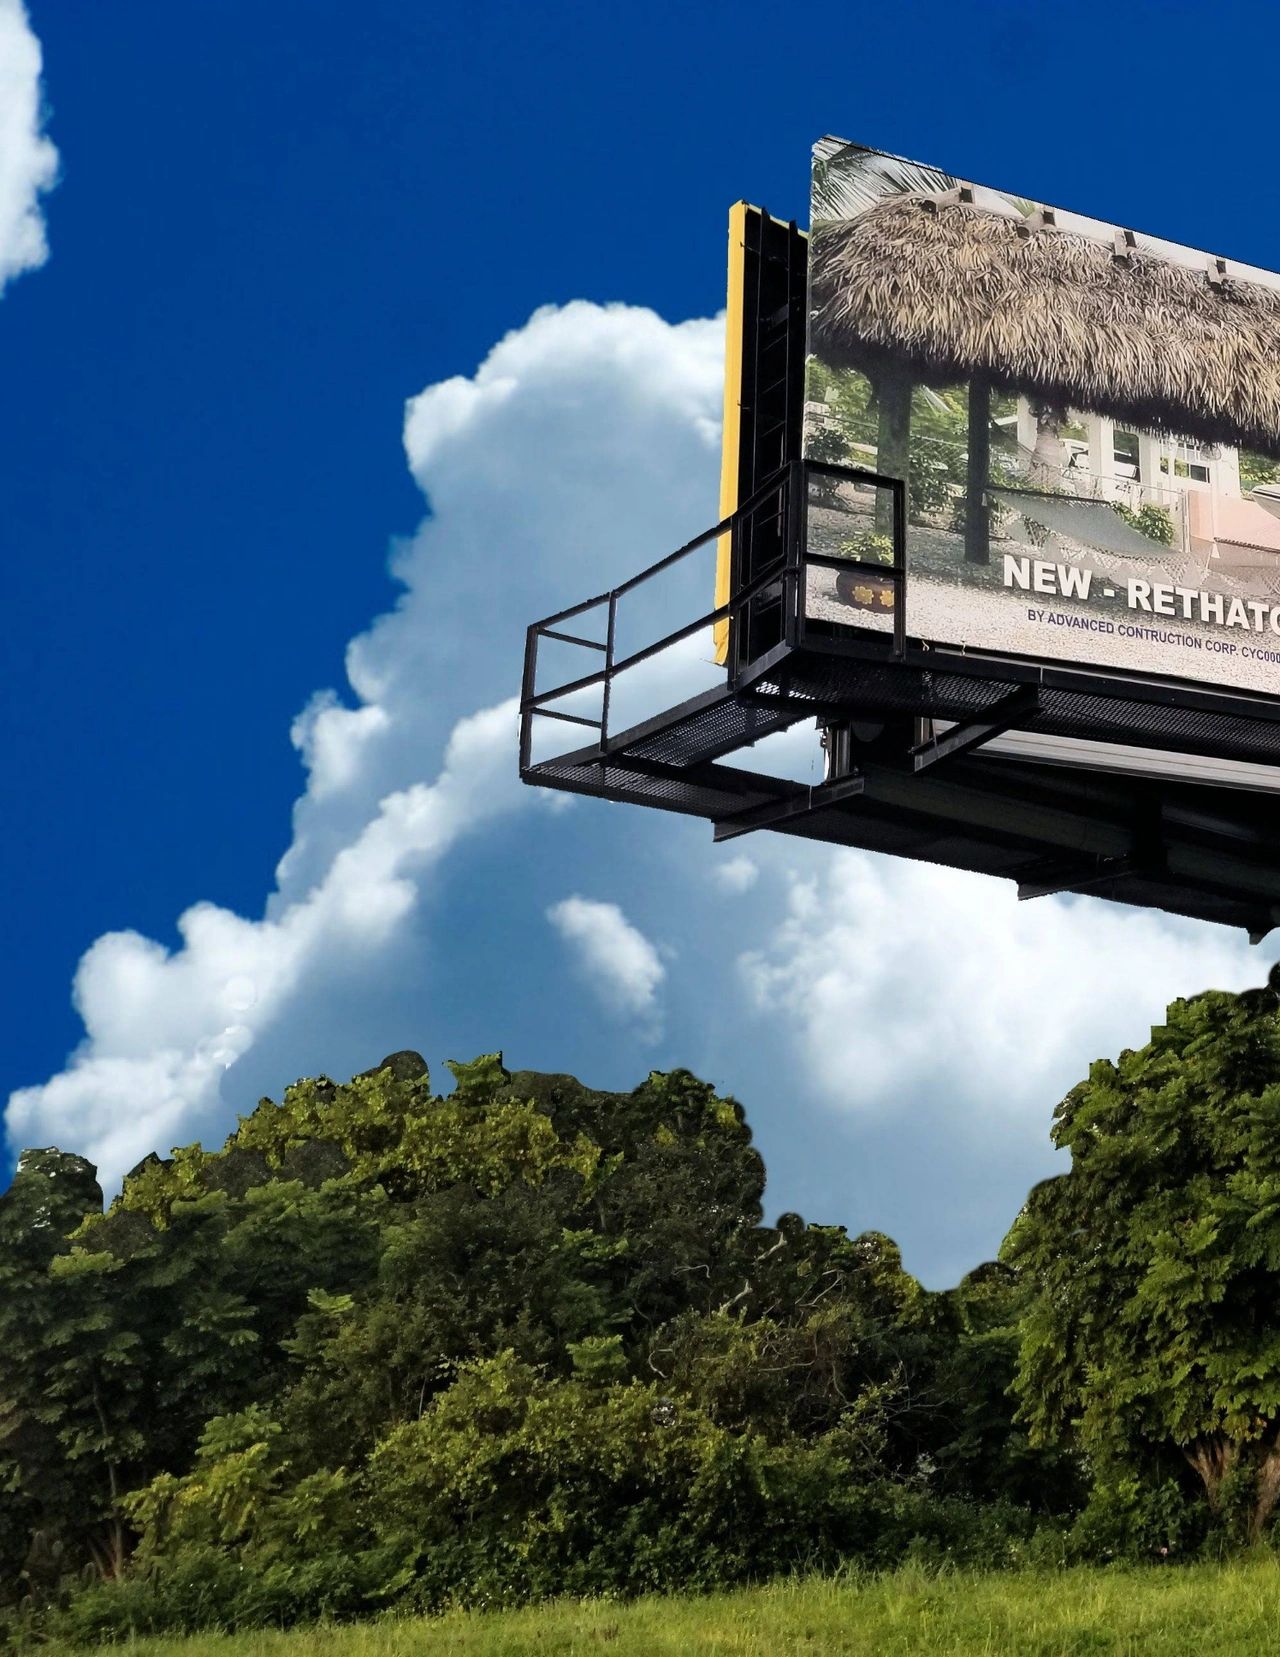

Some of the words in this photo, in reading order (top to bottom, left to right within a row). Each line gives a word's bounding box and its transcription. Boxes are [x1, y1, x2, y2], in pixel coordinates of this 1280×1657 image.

[1003, 553, 1092, 600] NEW
[1027, 608, 1045, 623] BY
[1047, 611, 1115, 634] ADVANCED
[1118, 624, 1202, 649] CONTRUCTION
[1205, 639, 1239, 656] CORP.
